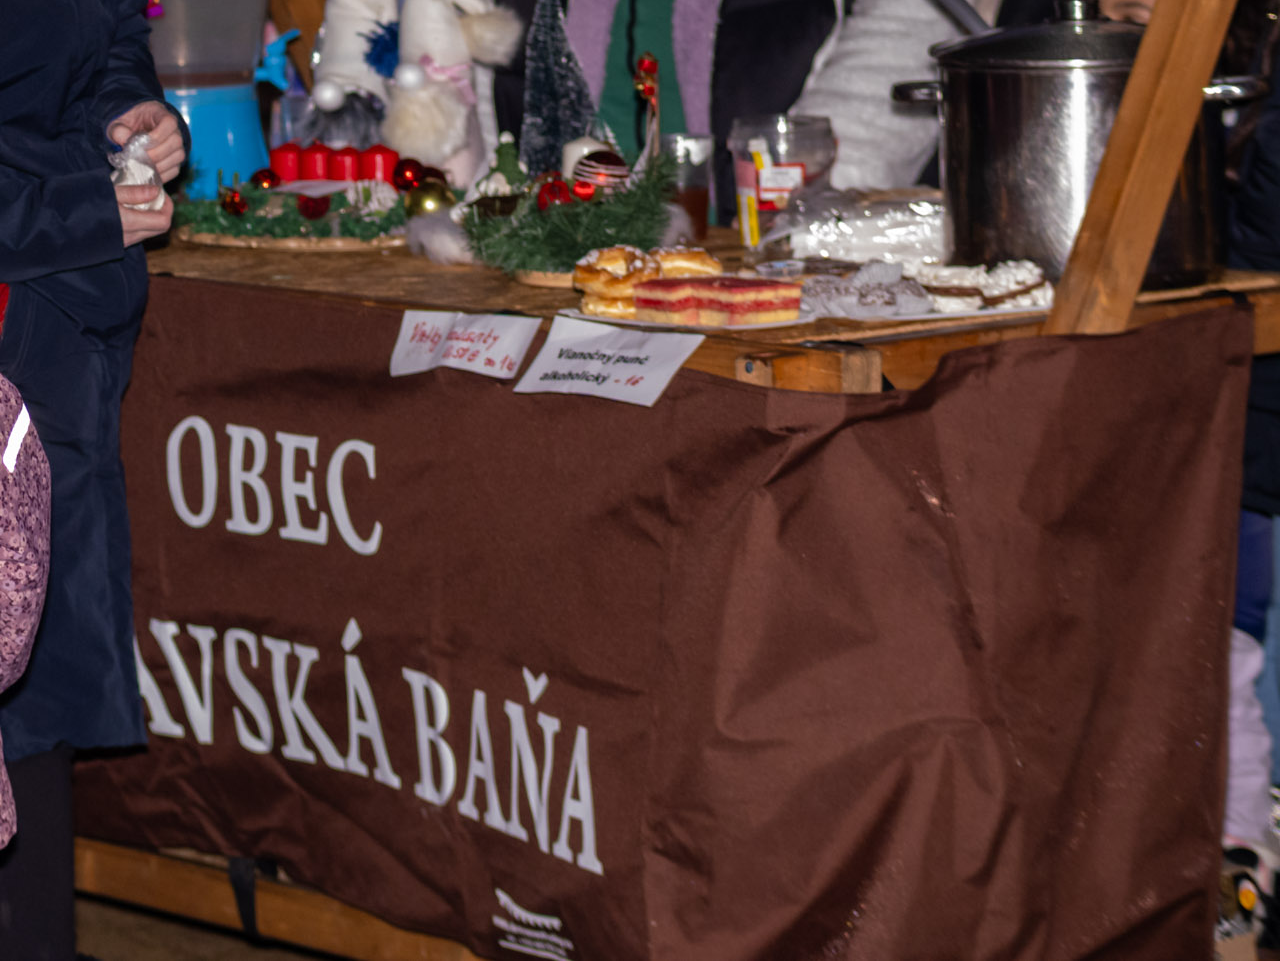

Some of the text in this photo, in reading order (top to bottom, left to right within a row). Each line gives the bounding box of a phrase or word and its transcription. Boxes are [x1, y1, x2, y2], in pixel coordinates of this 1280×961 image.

[558, 347, 614, 365] Vianočný
[166, 415, 383, 556] OBEC
[132, 617, 604, 876] AVSKÁ BAŇA
